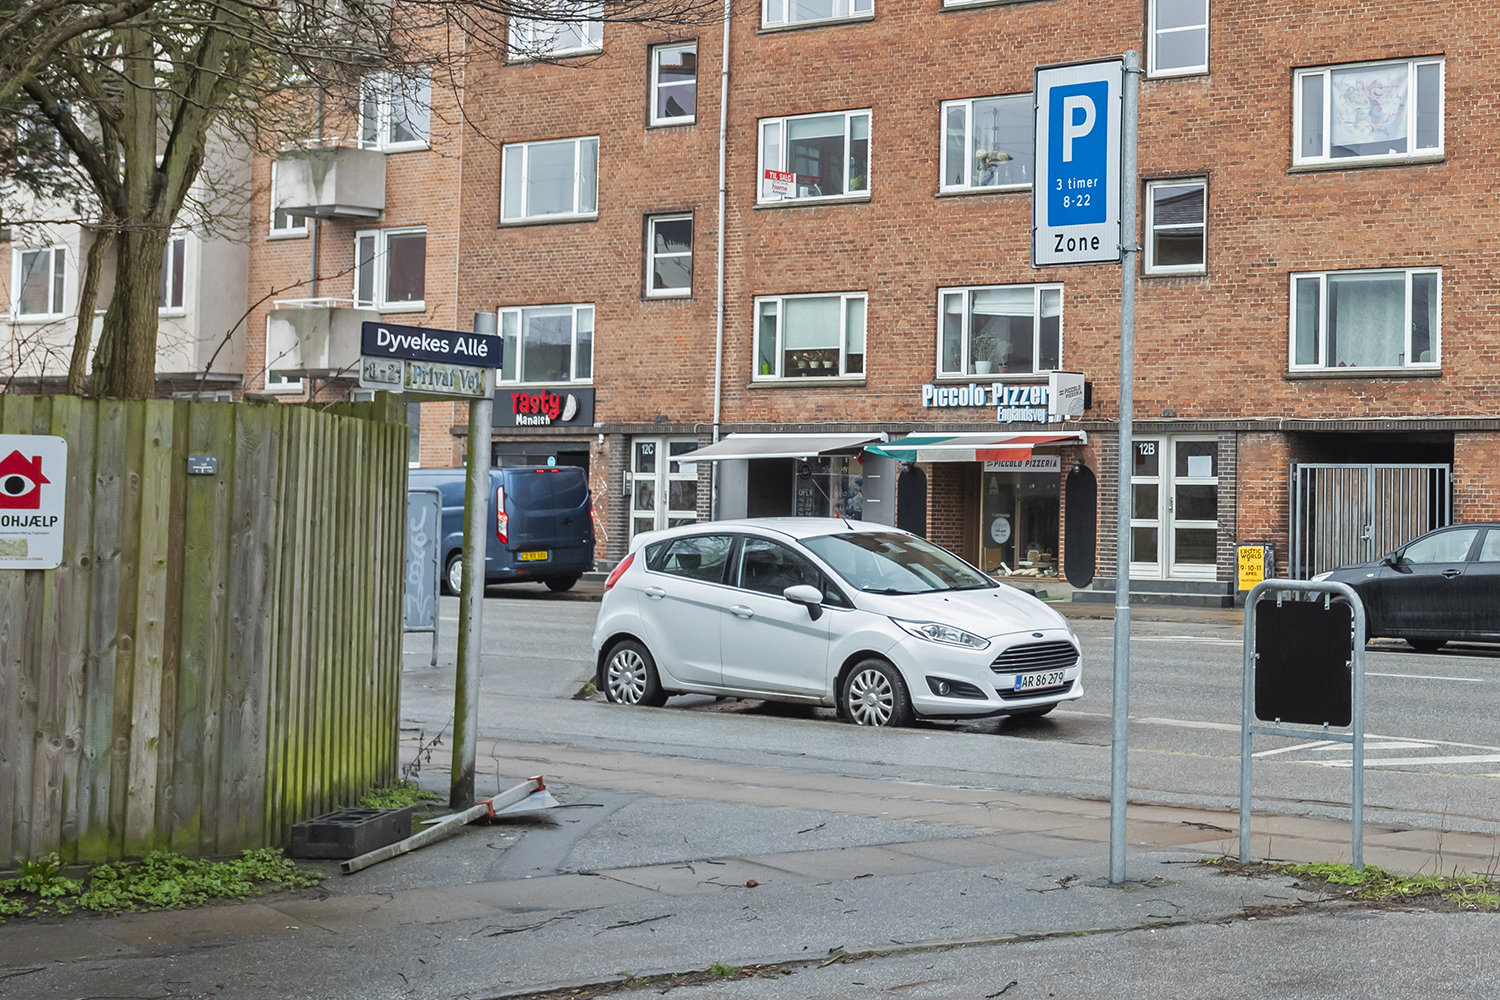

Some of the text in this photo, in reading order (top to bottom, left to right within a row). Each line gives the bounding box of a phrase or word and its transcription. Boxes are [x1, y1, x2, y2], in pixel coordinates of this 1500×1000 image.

[1062, 94, 1097, 163] P
[769, 171, 777, 180] TIL
[1056, 177, 1098, 191] 3 timer
[1063, 194, 1091, 208] 8-22
[1054, 233, 1100, 253] Zone
[377, 328, 488, 357] Dyvekes Allé
[412, 364, 480, 394] Privat Vej
[922, 383, 1050, 408] Piccolo Pizzer
[511, 389, 560, 420] Tasty
[516, 413, 551, 425] Manaish
[997, 406, 1047, 424] Englandsvej
[641, 444, 654, 455] 12C
[1139, 443, 1155, 455] 12B
[993, 460, 1057, 468] PICCOLO PIZZERIA
[0, 515, 58, 528] OHJÆLP
[1021, 672, 1063, 687] AR 86 279
